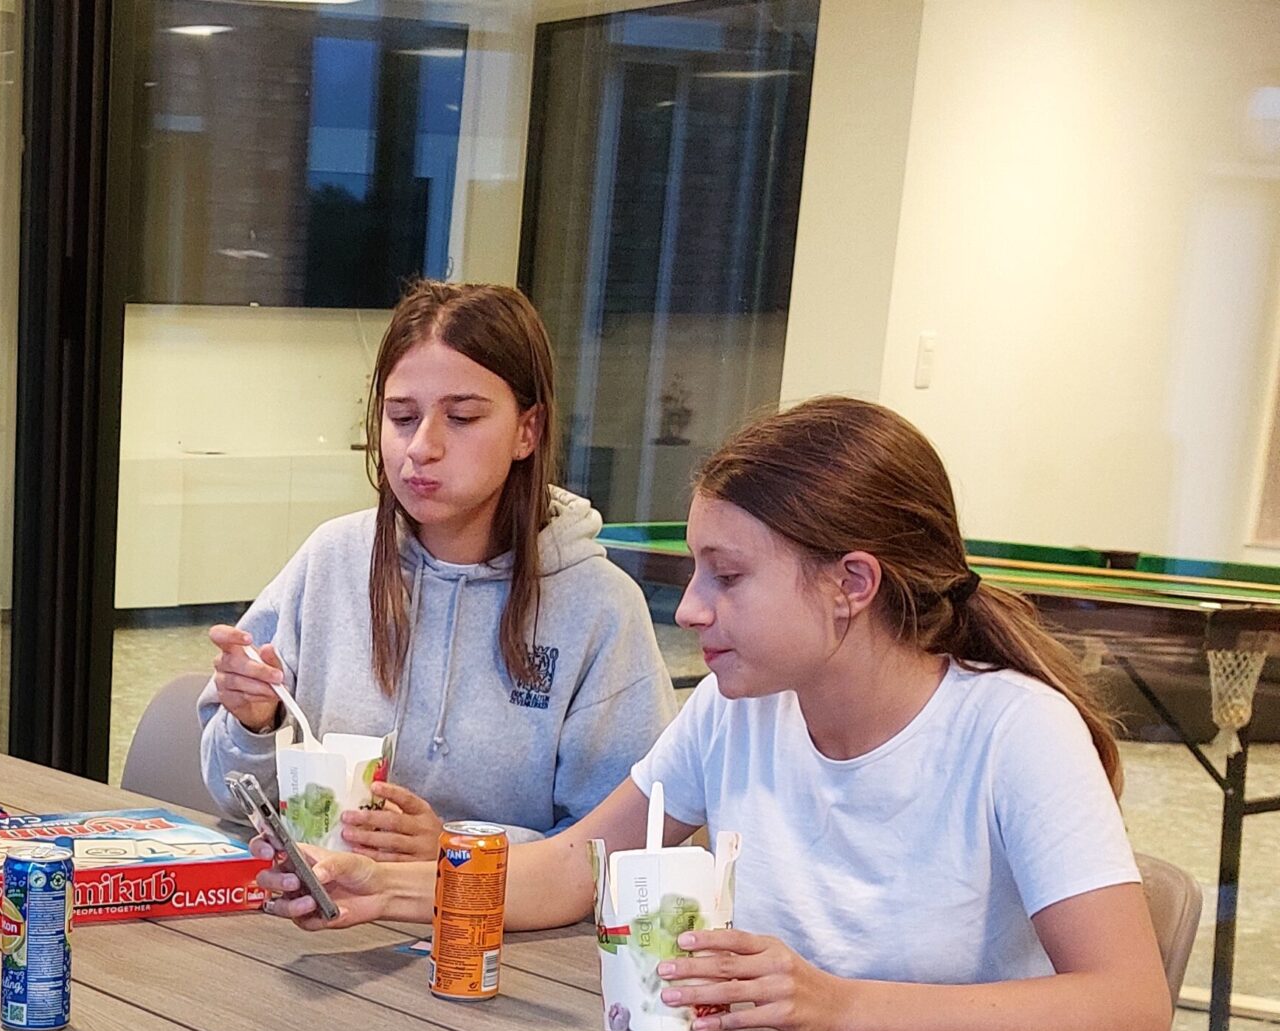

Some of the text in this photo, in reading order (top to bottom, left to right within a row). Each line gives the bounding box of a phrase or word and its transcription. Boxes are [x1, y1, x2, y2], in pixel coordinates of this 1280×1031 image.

[171, 887, 245, 908] CLASSIC
[104, 904, 151, 914] TOGETHER
[634, 876, 650, 948] tagliatelli
